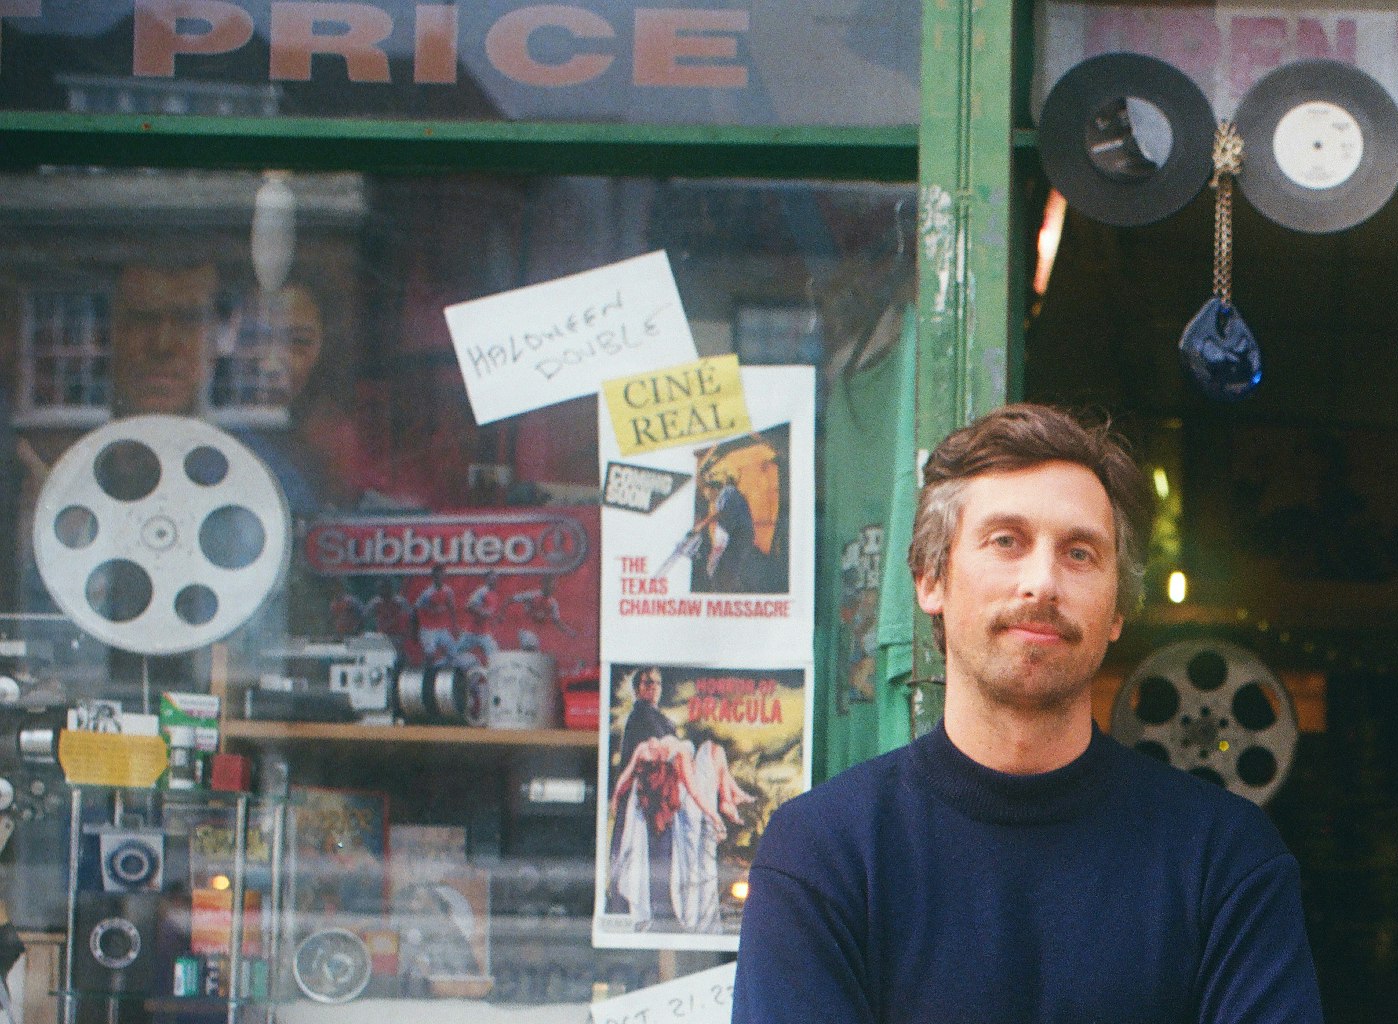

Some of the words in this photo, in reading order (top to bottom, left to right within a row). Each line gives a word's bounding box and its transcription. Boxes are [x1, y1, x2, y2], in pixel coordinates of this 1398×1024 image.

[132, 0, 750, 87] PRICE
[534, 302, 672, 381] DOUBLE
[629, 402, 736, 447] REAL
[609, 465, 673, 495] COMING
[605, 484, 652, 510] SOON
[316, 528, 535, 566] Subbuteo
[618, 556, 648, 574] THE
[619, 577, 669, 595] TEXAS
[618, 599, 702, 617] CHAINSAW
[705, 600, 792, 618] MASSACRE
[686, 696, 783, 724] DRACULA
